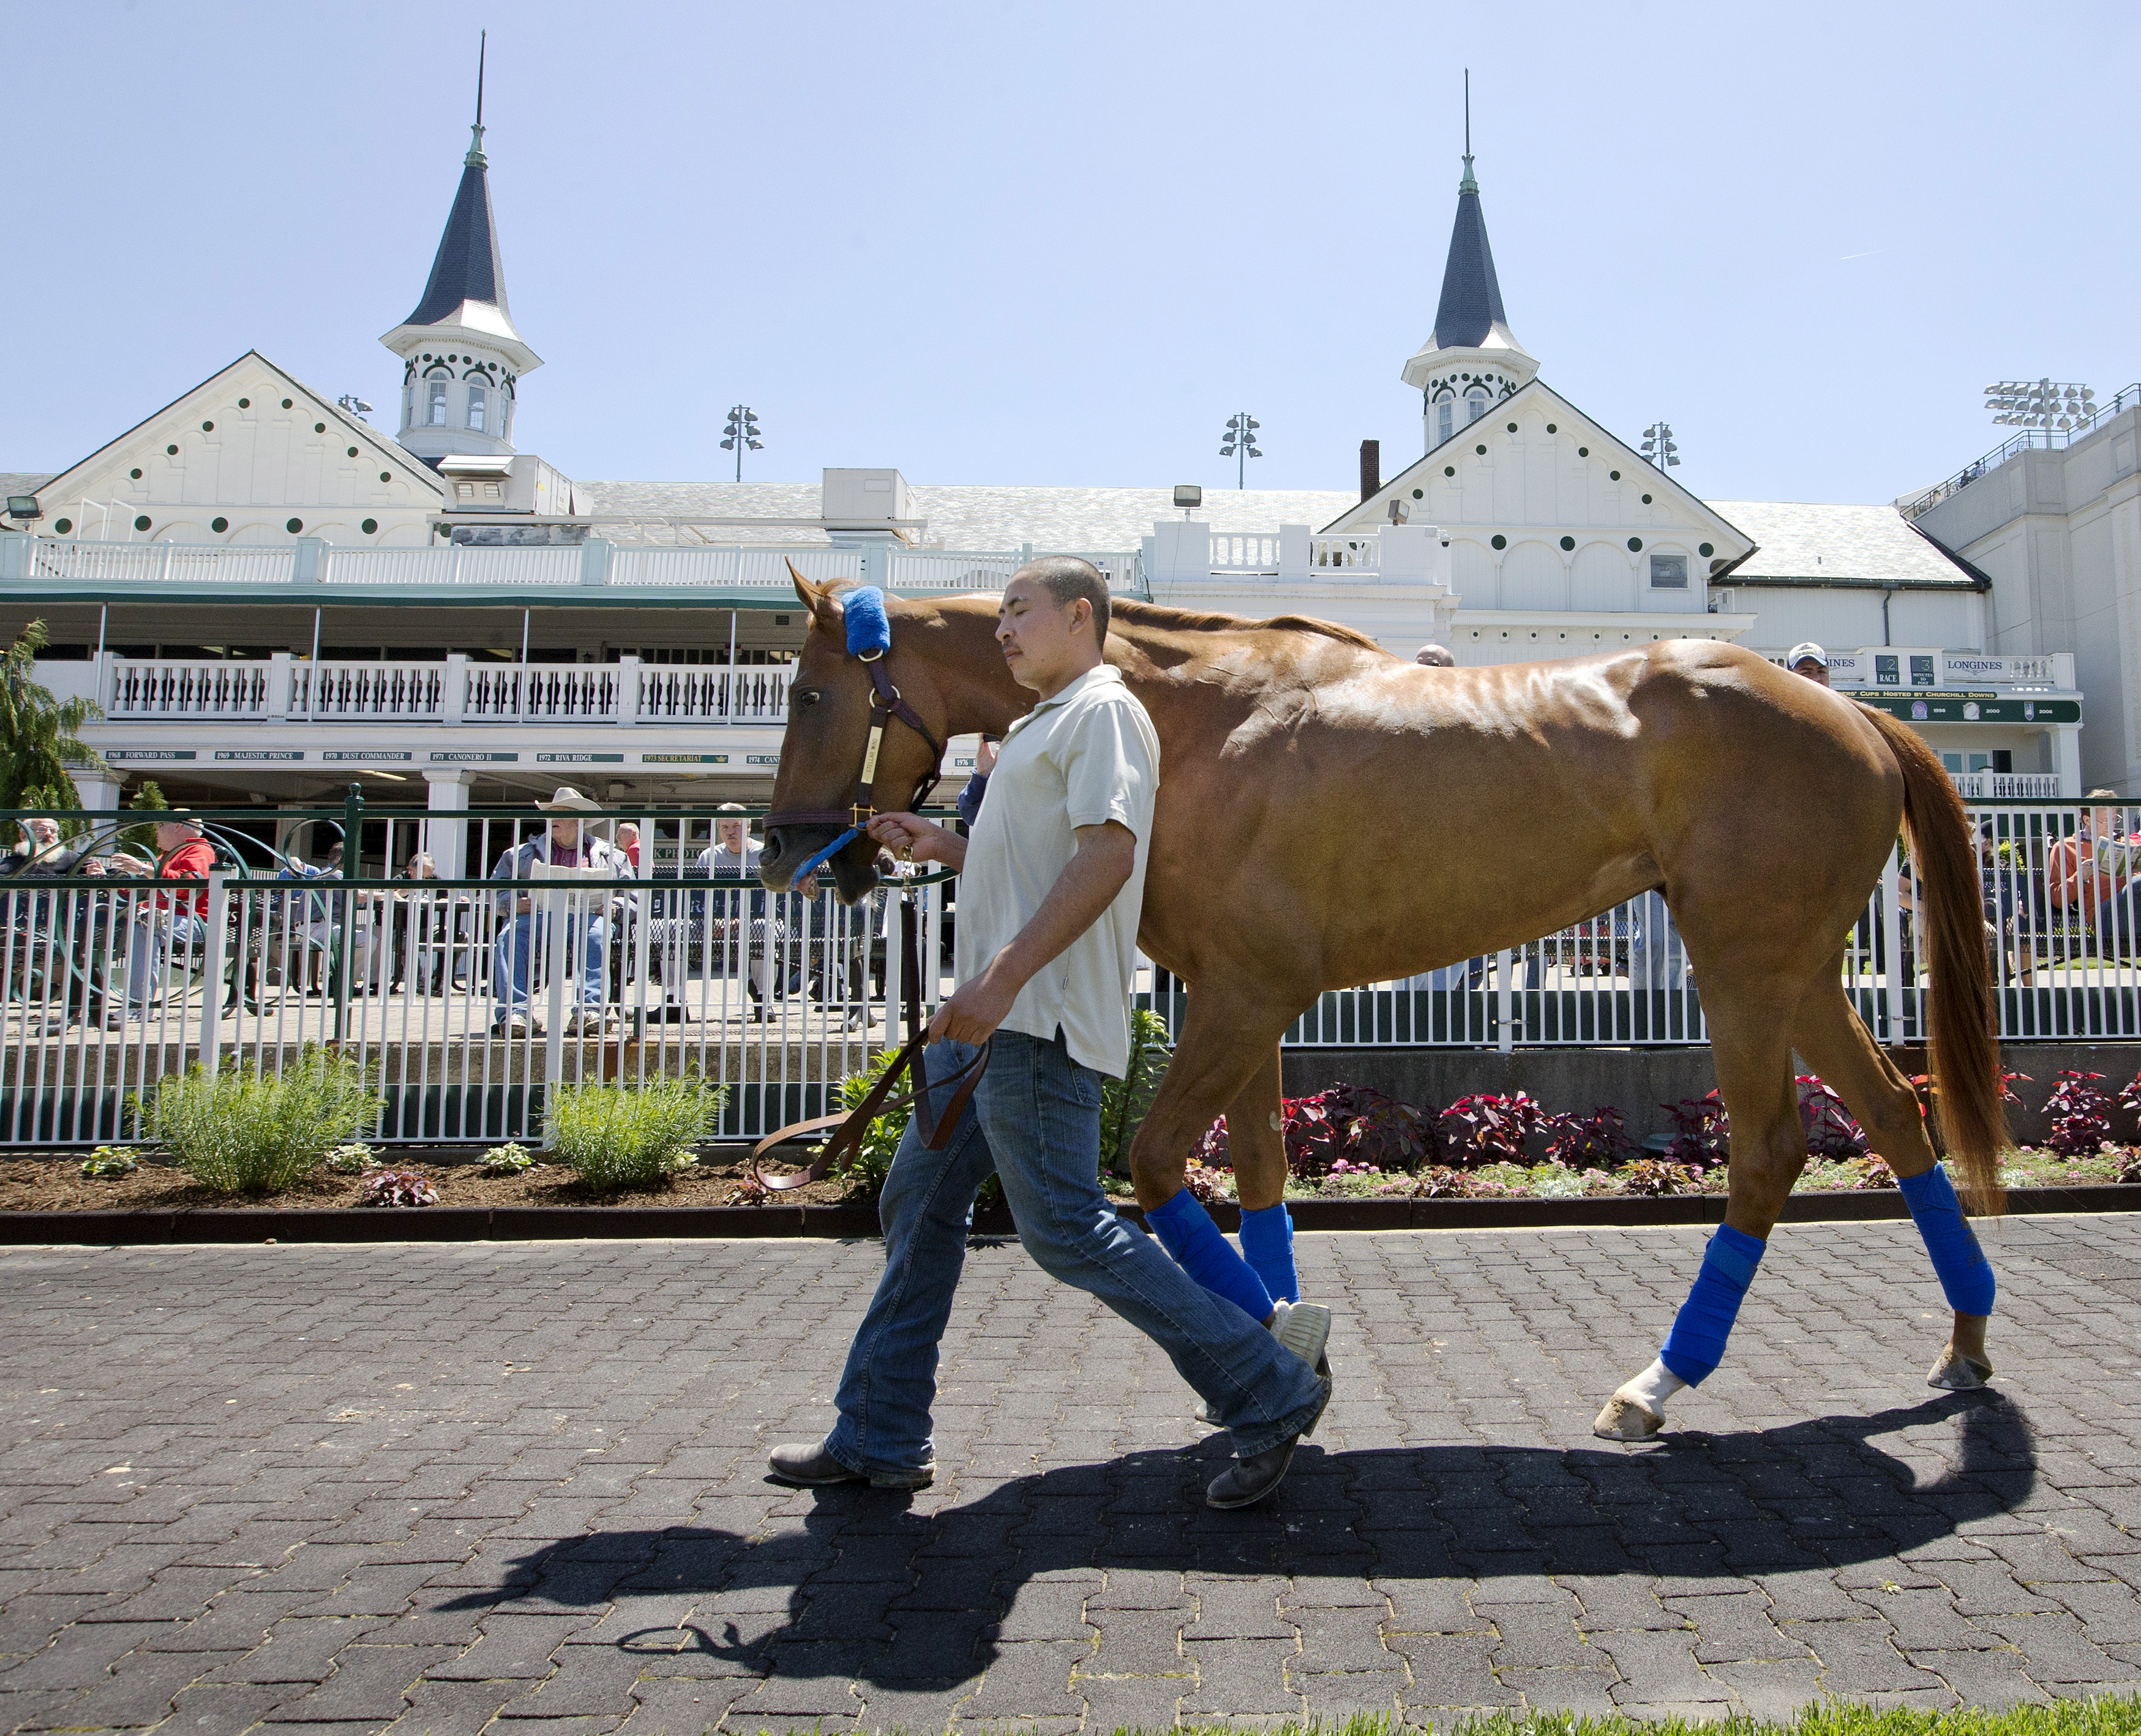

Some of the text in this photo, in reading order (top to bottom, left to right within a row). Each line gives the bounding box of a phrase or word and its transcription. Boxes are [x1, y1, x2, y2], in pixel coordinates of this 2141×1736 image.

[1948, 660, 2003, 670] LONGINES
[1880, 674, 1897, 683] RACE
[866, 751, 875, 773] STELLAR
